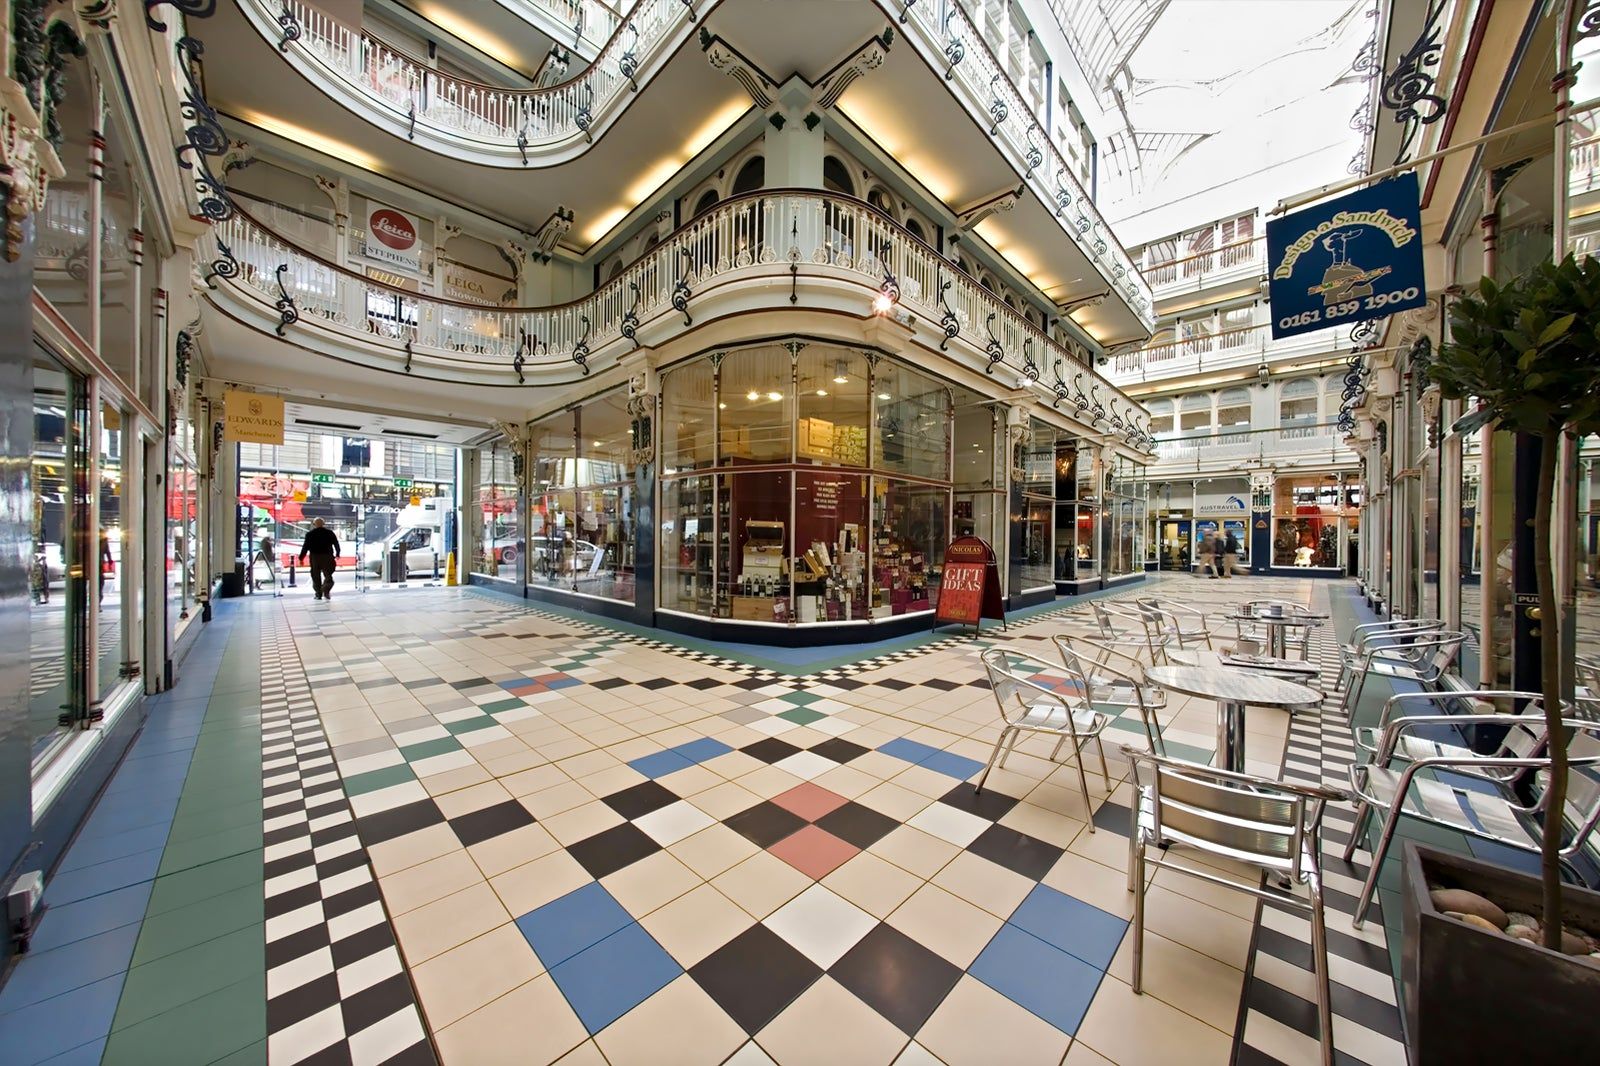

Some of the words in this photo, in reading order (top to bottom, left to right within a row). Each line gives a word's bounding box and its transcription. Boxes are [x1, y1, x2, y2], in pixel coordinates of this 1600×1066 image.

[372, 217, 413, 241] Leica
[1274, 227, 1319, 280] Design
[1316, 221, 1330, 234] a
[1332, 208, 1417, 248] Sandwich
[368, 247, 417, 267] STEPHENS
[447, 275, 484, 294] LEICA
[1279, 310, 1321, 329] 0161
[1325, 300, 1360, 319] 839
[1364, 287, 1419, 309] 1900
[228, 416, 283, 427] EDWARDS
[945, 568, 982, 581] GIFT
[943, 579, 981, 592] IDEAS
[1518, 595, 1541, 604] PUL
